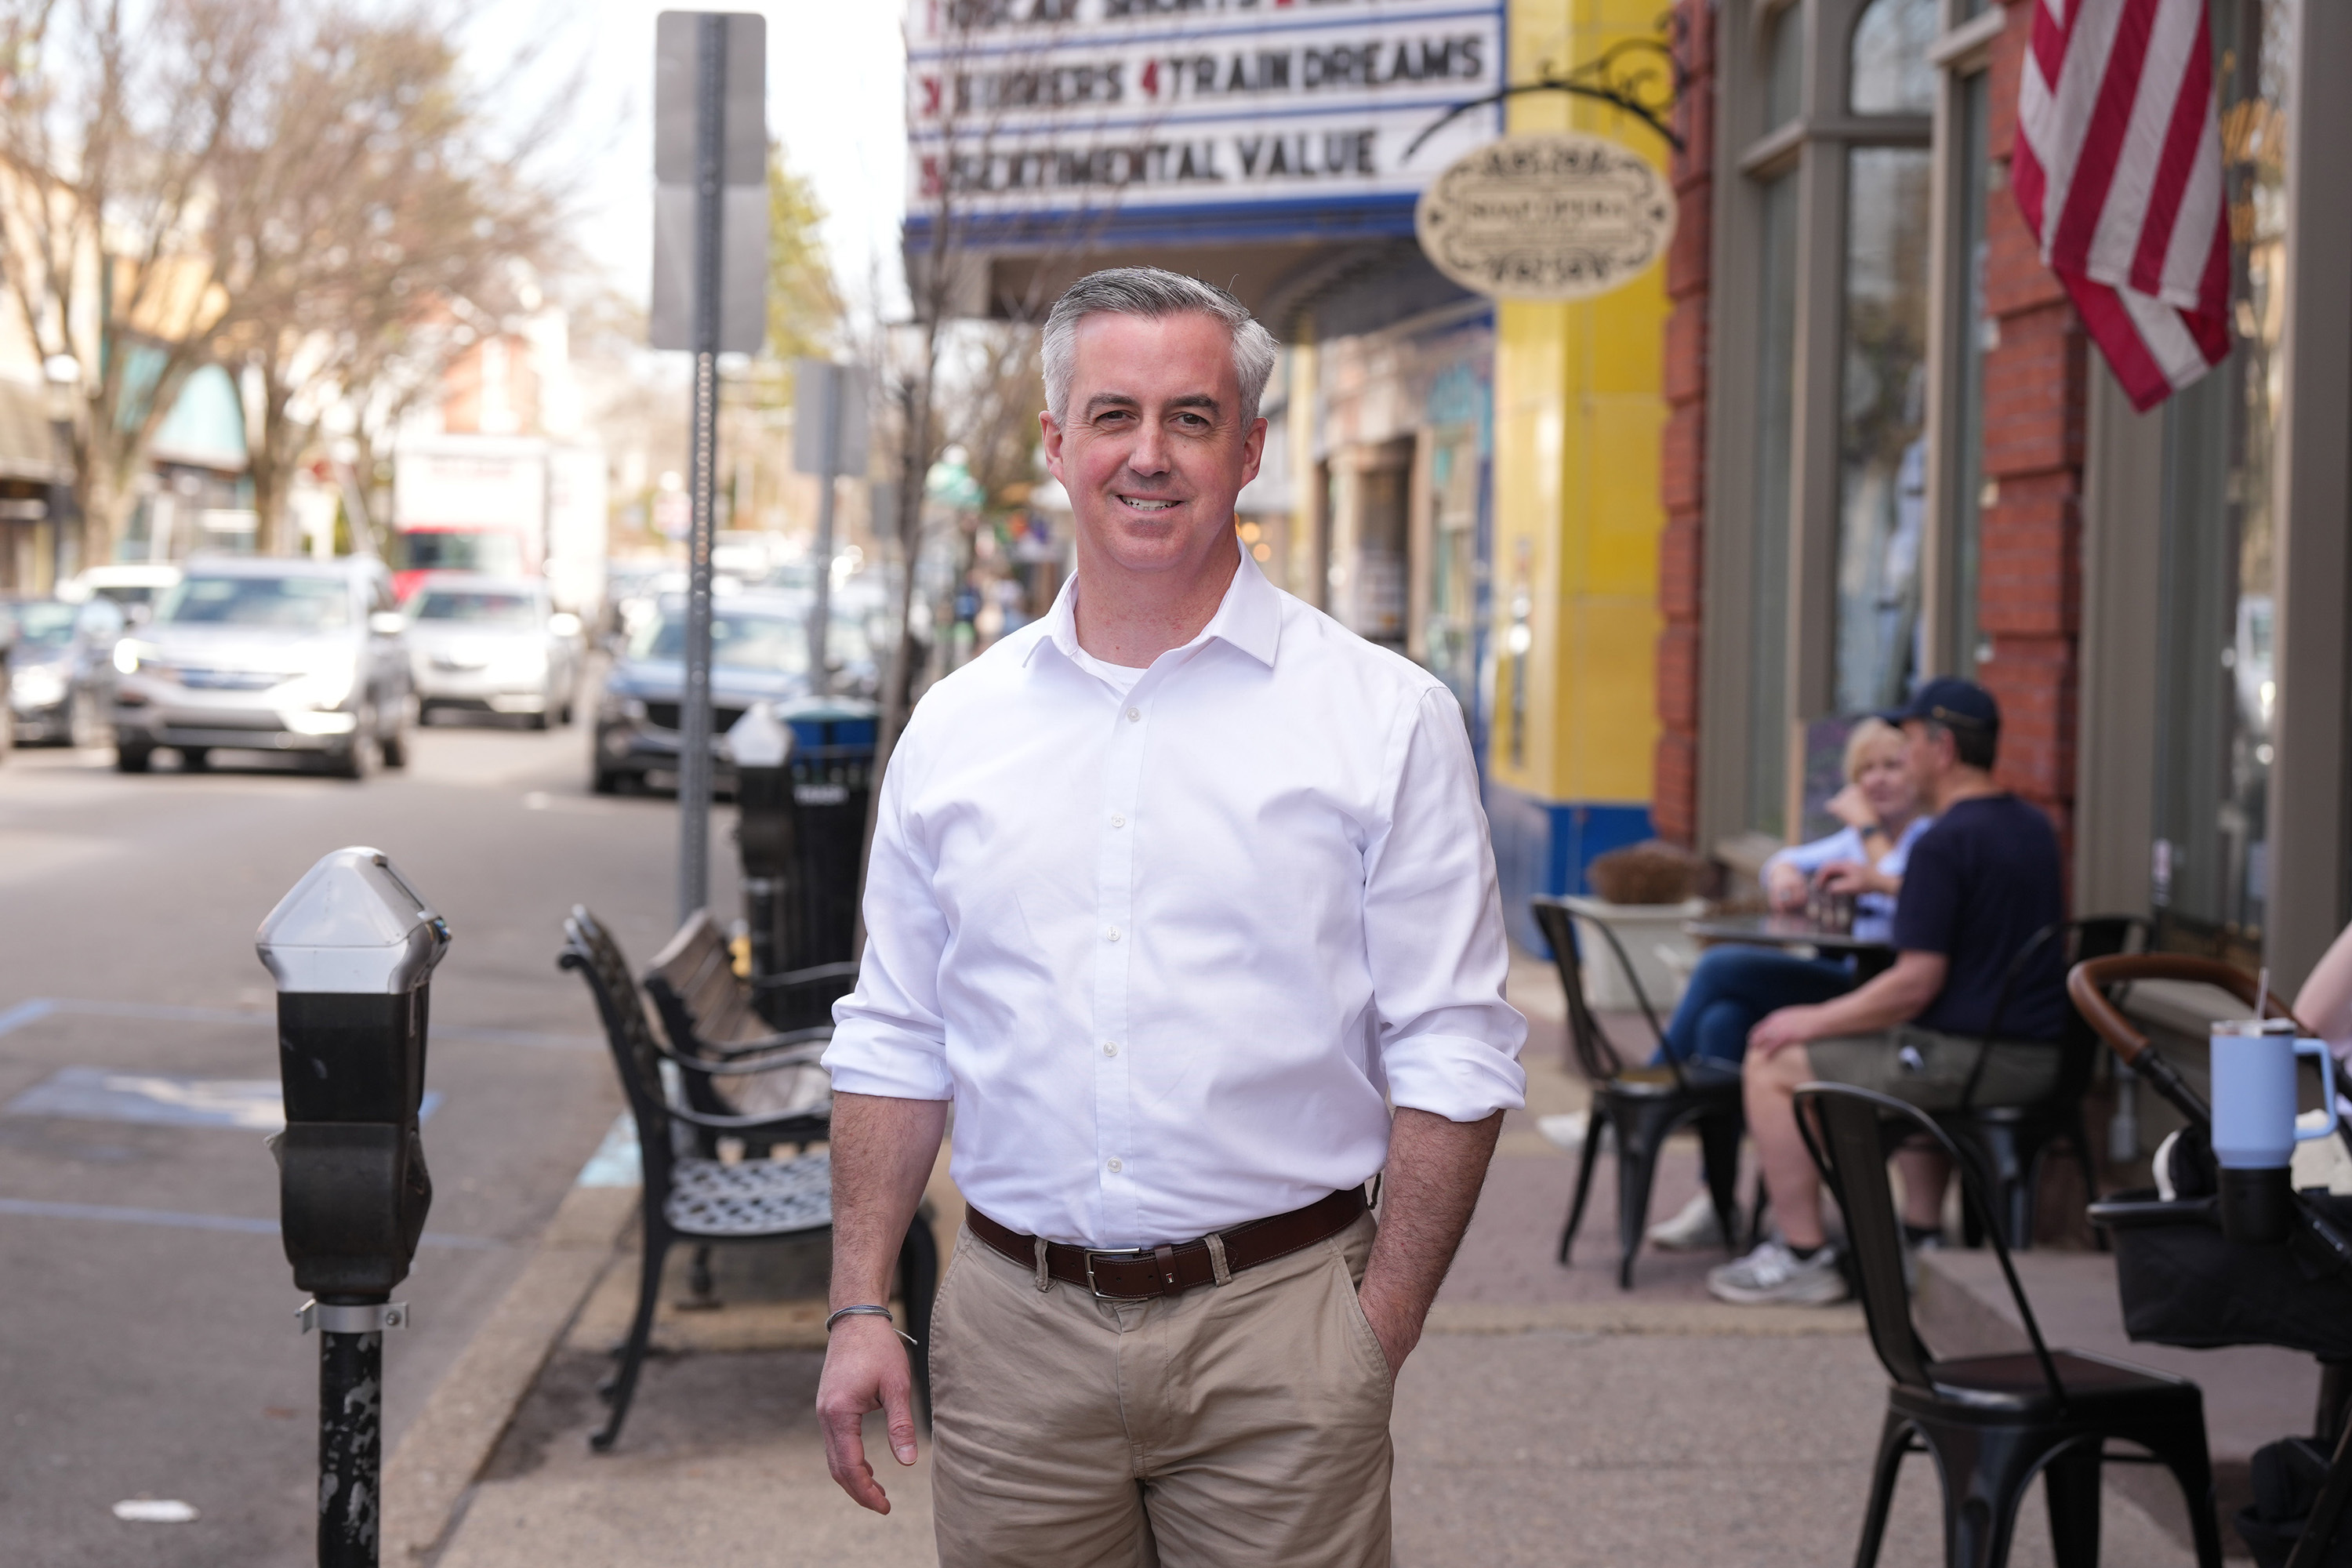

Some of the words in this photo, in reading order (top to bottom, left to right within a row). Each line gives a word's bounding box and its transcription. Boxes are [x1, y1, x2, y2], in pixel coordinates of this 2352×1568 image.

[1170, 53, 1290, 97] TRAIN
[1302, 34, 1483, 90] DREAMS
[1237, 131, 1376, 176] VALUE
